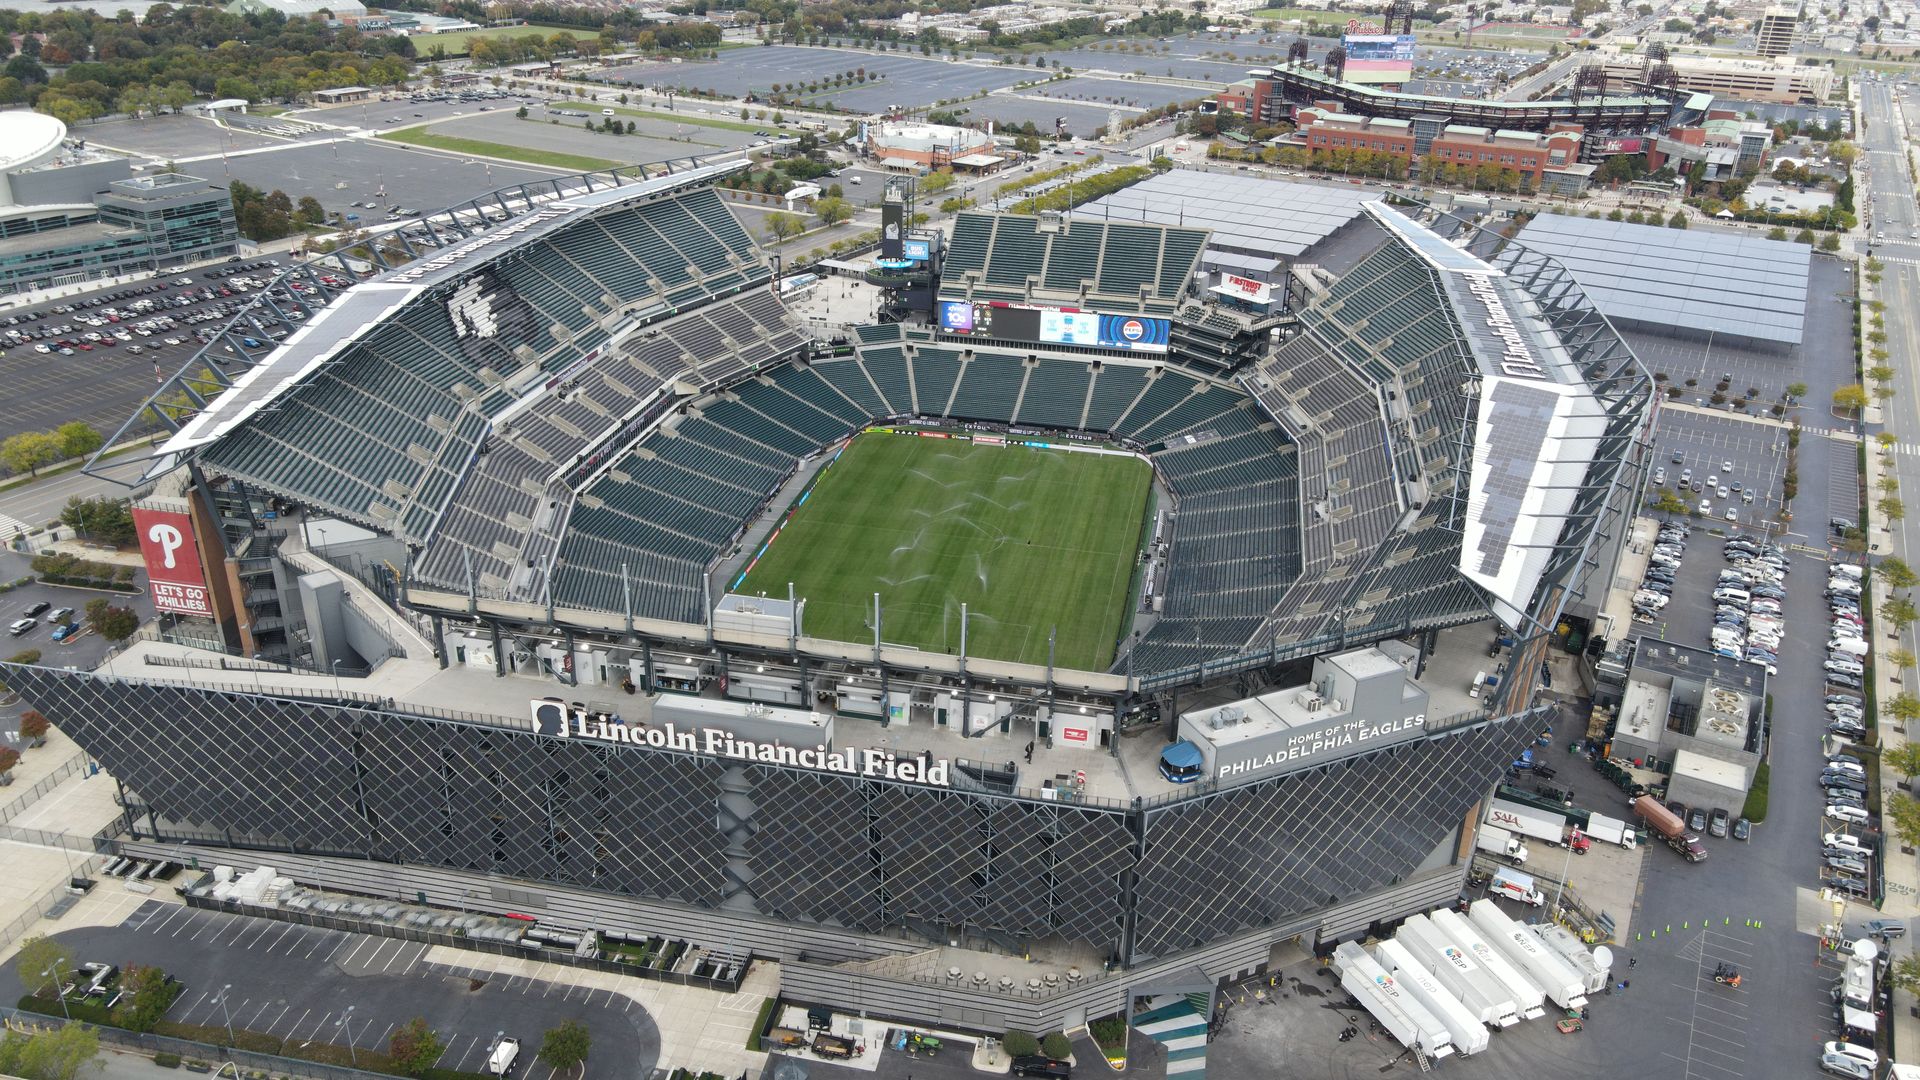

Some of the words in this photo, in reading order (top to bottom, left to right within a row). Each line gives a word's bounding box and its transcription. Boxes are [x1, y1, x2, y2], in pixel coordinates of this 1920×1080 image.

[1347, 19, 1385, 35] Phillies
[148, 523, 183, 569] P
[154, 584, 183, 597] LET'S
[186, 588, 203, 600] GO
[157, 595, 206, 611] PHILLIES!
[1219, 734, 1352, 778] PHILADELPHIA
[1358, 714, 1425, 742] EAGLES
[1288, 731, 1321, 747] HOME
[1325, 725, 1340, 737] OF
[1343, 719, 1366, 732] THE
[575, 709, 698, 752] Lincoln
[703, 728, 856, 774] Financial
[862, 748, 949, 786] Field
